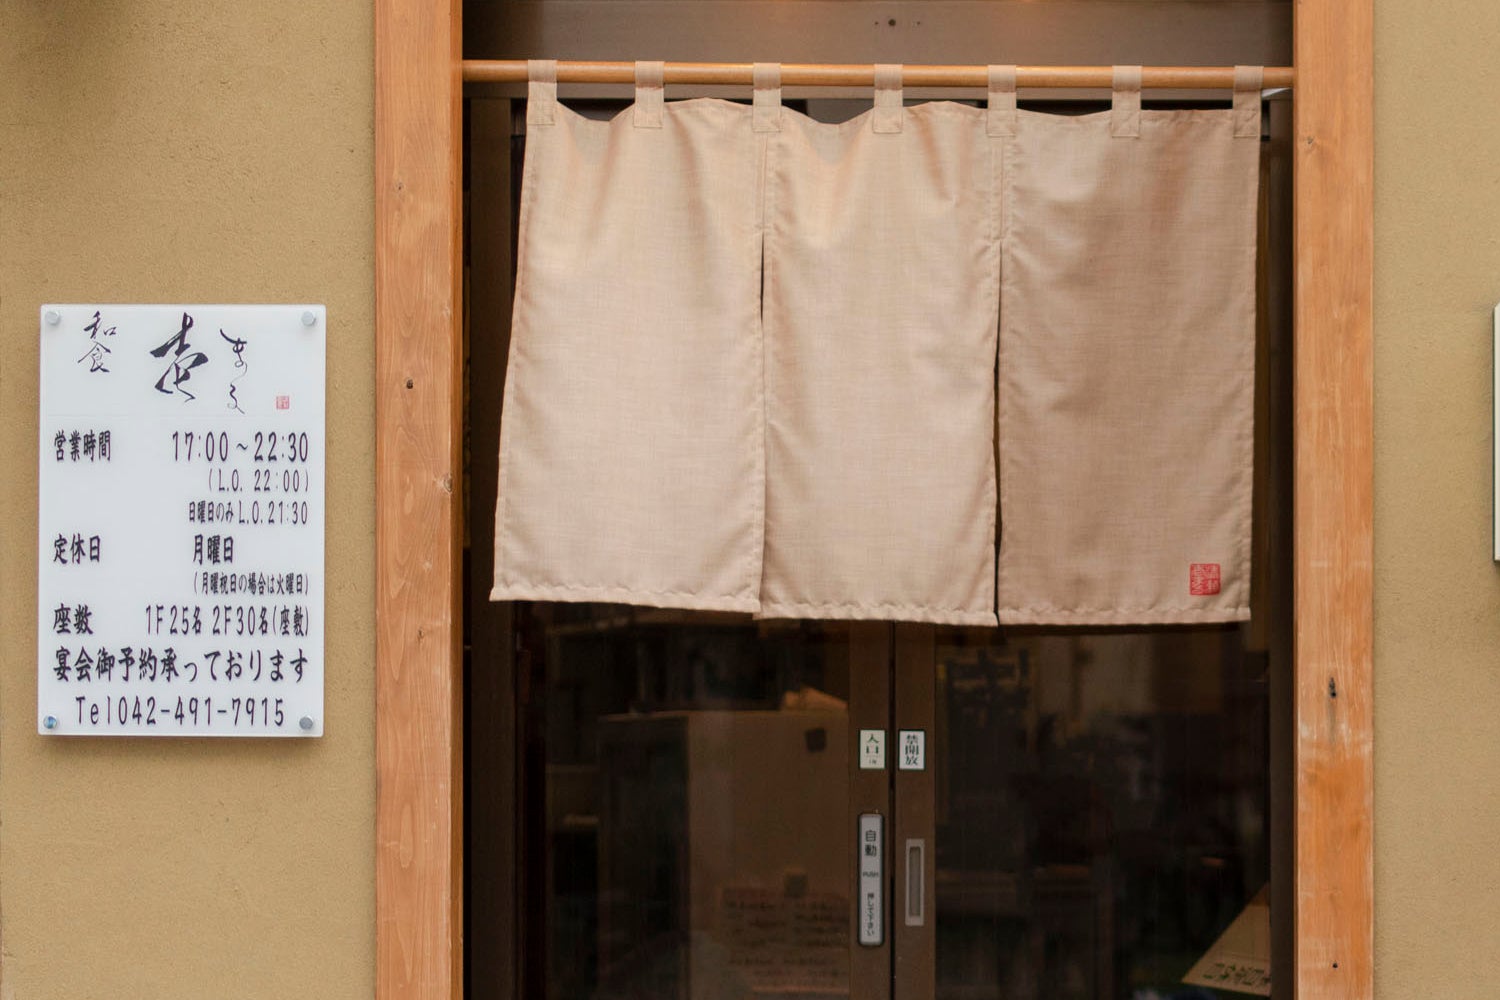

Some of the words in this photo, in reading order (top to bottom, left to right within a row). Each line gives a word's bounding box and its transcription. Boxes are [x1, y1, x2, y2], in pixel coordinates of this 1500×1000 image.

[77, 310, 117, 373] 和食
[54, 429, 112, 463] 営業時間
[53, 533, 102, 565] 定休日
[192, 533, 235, 566] 月曜日
[193, 571, 310, 596] (月曜祝日の場合は火曜日)
[53, 602, 94, 636] 座数
[53, 646, 309, 683] 宴会御予約承っております
[866, 733, 881, 754] 入口
[864, 829, 877, 858] 自動
